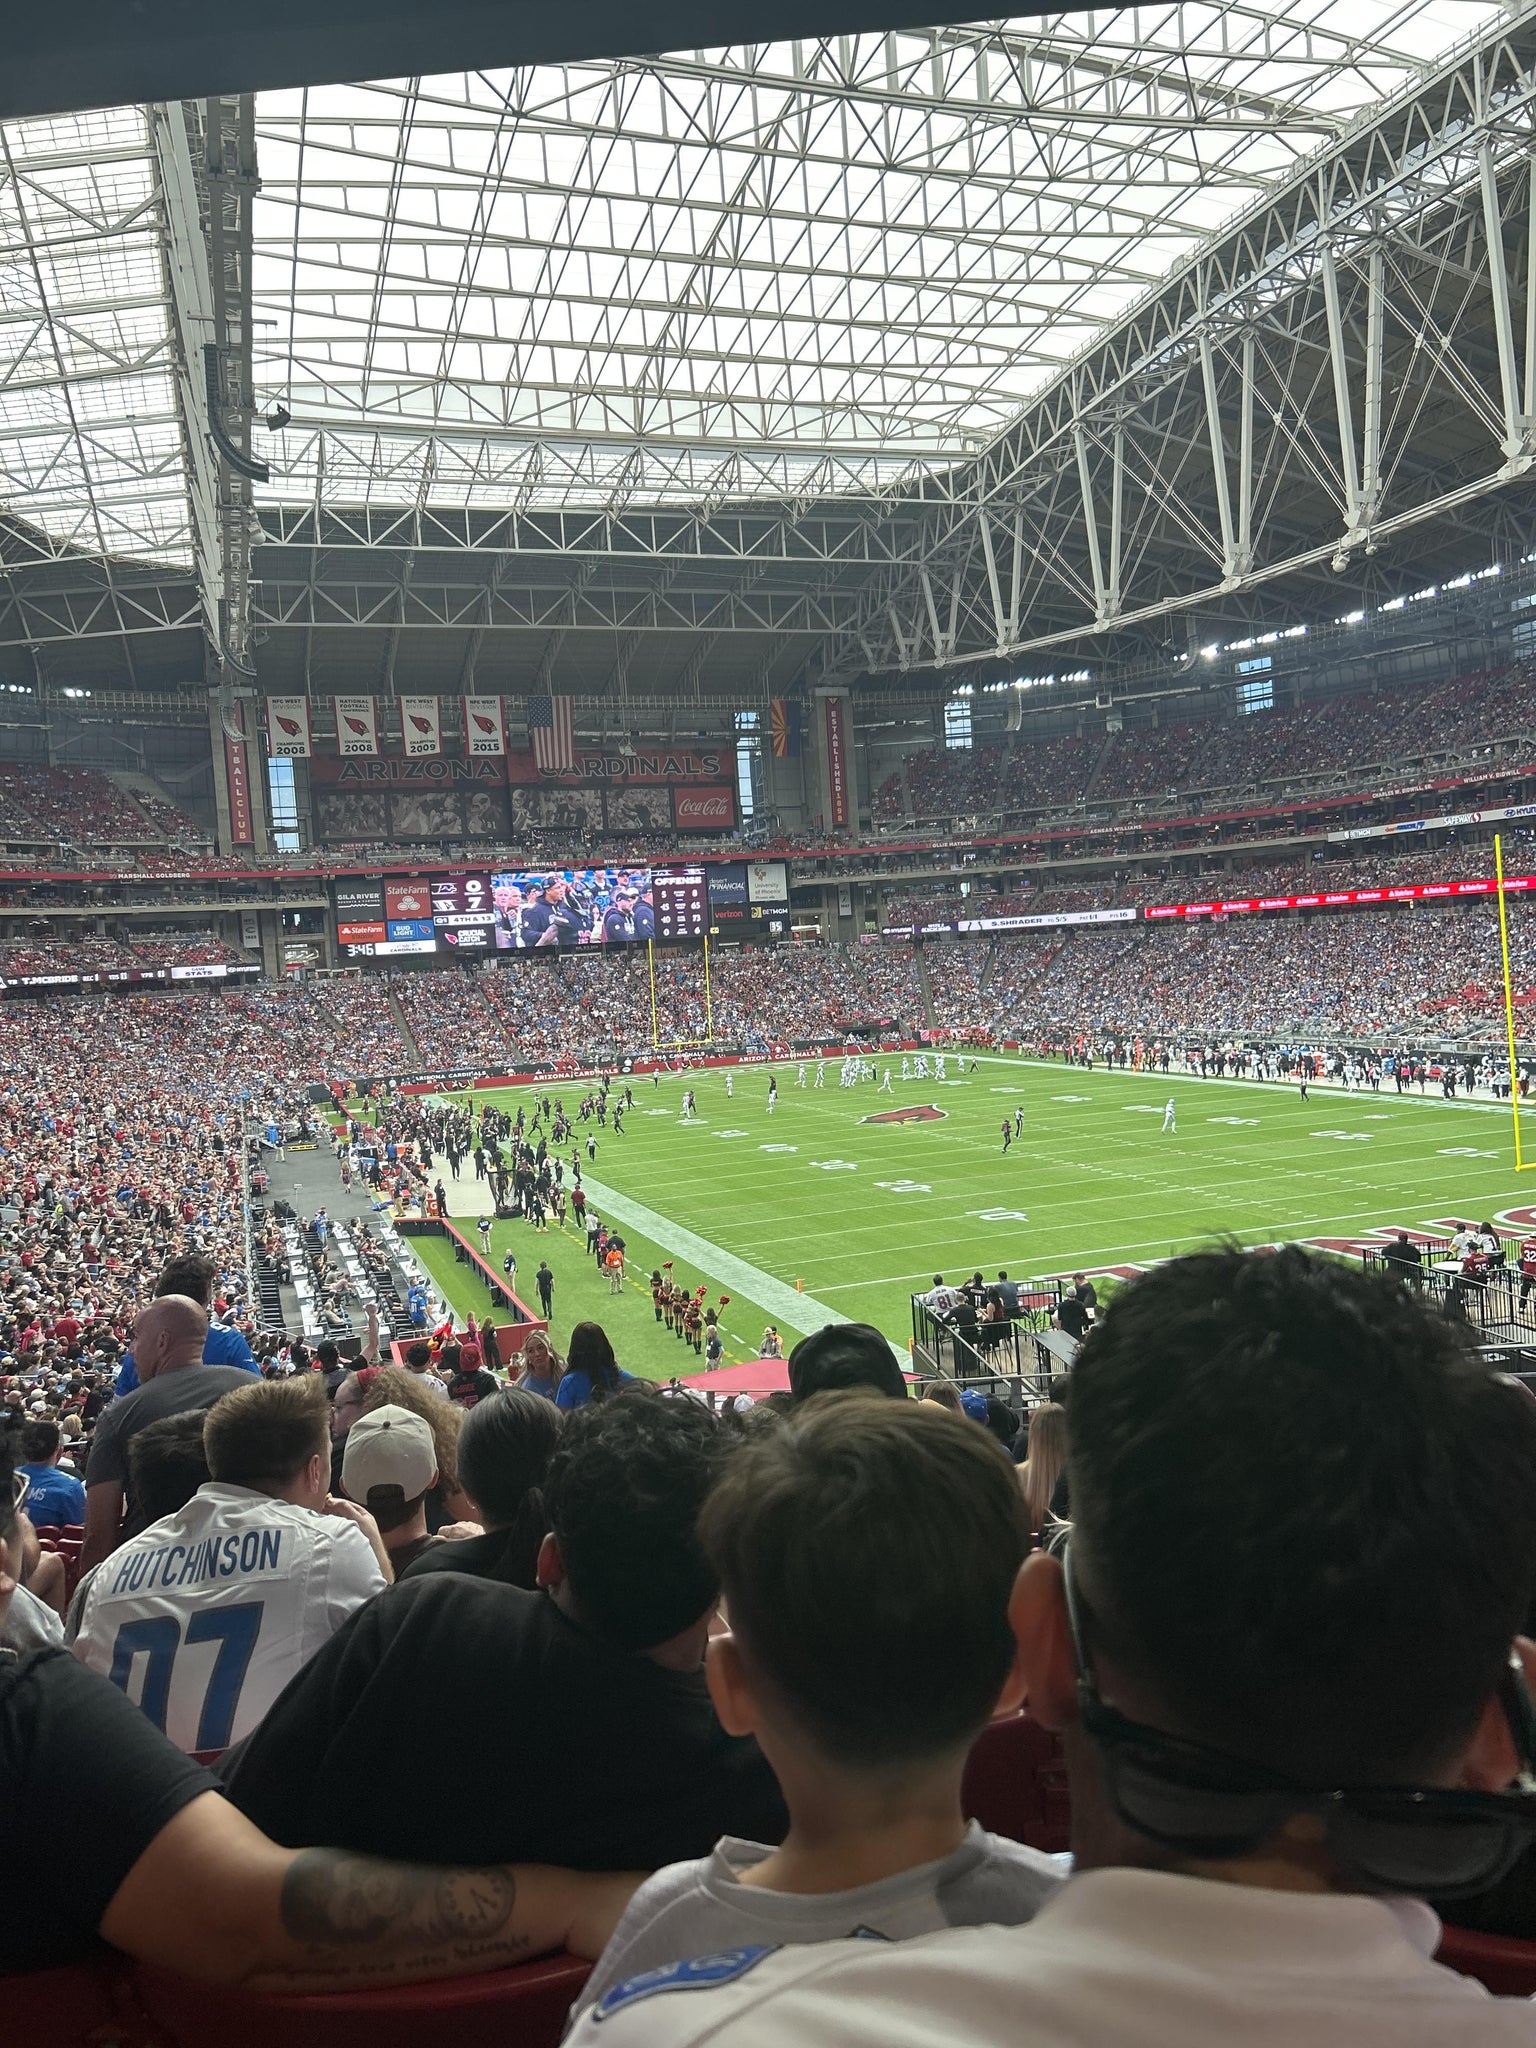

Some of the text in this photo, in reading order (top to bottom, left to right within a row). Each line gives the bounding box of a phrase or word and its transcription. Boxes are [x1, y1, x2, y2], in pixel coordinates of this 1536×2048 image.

[276, 747, 305, 755] 2008
[345, 744, 373, 752] 2008
[410, 744, 436, 753] 2009
[473, 743, 500, 751] 2015
[831, 711, 841, 792] ESTABLISHED
[338, 759, 501, 781] ARIZONA
[1463, 774, 1488, 783] WILLIAM
[236, 800, 247, 839] CLUB
[1443, 815, 1472, 825] SAFEWAY
[654, 876, 702, 886] OFFENSE
[466, 880, 482, 893] 0
[468, 896, 482, 909] 7
[691, 902, 701, 910] 65
[692, 914, 701, 922] 73
[714, 910, 743, 918] verizon
[991, 918, 1042, 927] S.SHRADER
[694, 926, 701, 935] 6
[347, 943, 374, 957] 3:46
[22, 975, 78, 985] T.MCBRIDE
[533, 1072, 570, 1081] ARIZONA
[965, 1206, 1029, 1222] 10
[1524, 1249, 1536, 1262] 32
[111, 1530, 282, 1594] HUTCHINSON
